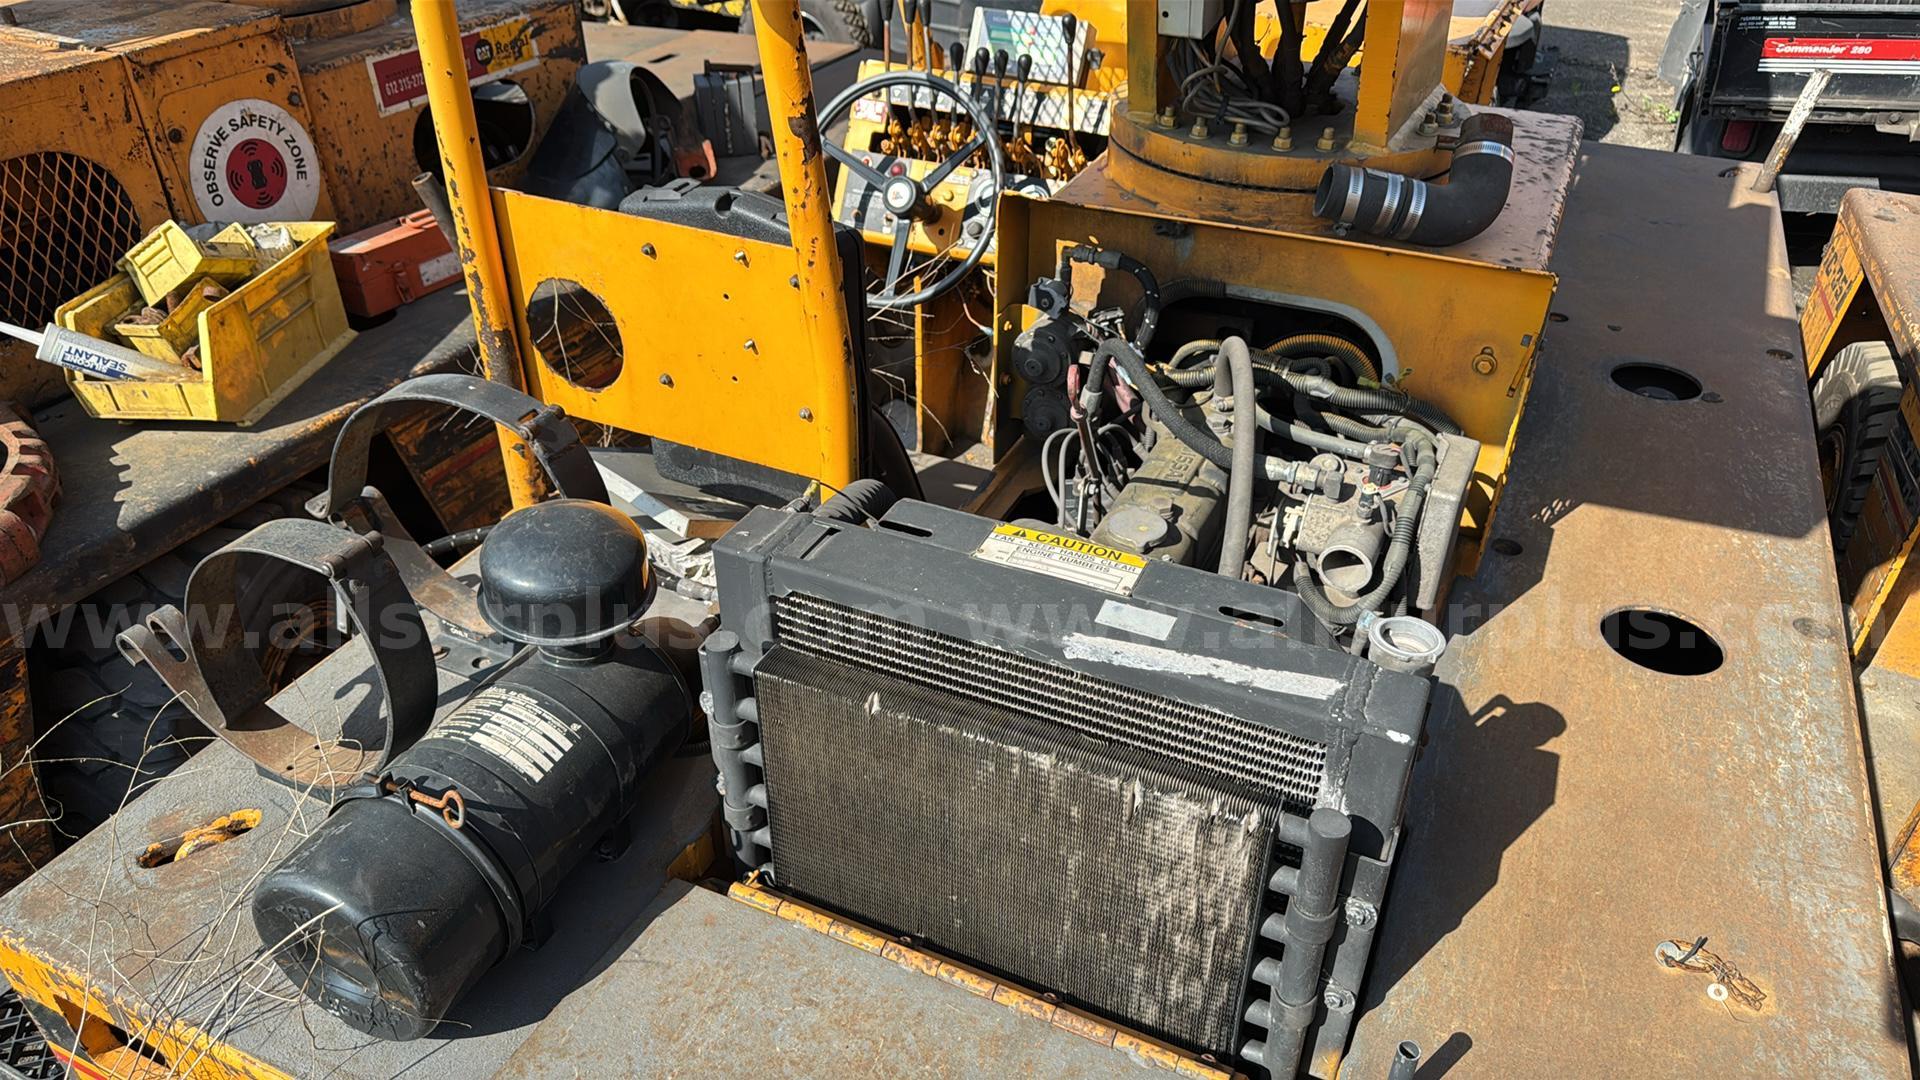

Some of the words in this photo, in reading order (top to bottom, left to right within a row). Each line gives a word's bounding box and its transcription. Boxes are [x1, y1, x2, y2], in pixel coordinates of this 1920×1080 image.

[475, 44, 492, 62] CAT
[1775, 44, 1846, 54] Commander
[204, 126, 230, 207] OBSERVE
[228, 113, 286, 136] SAFETY
[283, 134, 308, 181] ZONE
[63, 353, 108, 374] SILICONE
[65, 346, 128, 372] SEALANT
[993, 533, 1016, 544] FAN
[1028, 542, 1056, 552] KEEP
[1059, 547, 1096, 562] HANDS
[1099, 558, 1137, 573] CLEAR
[1015, 545, 1052, 559] ENGINE
[1058, 554, 1111, 573] NUMBERS
[1035, 533, 1122, 561] CAUTION
